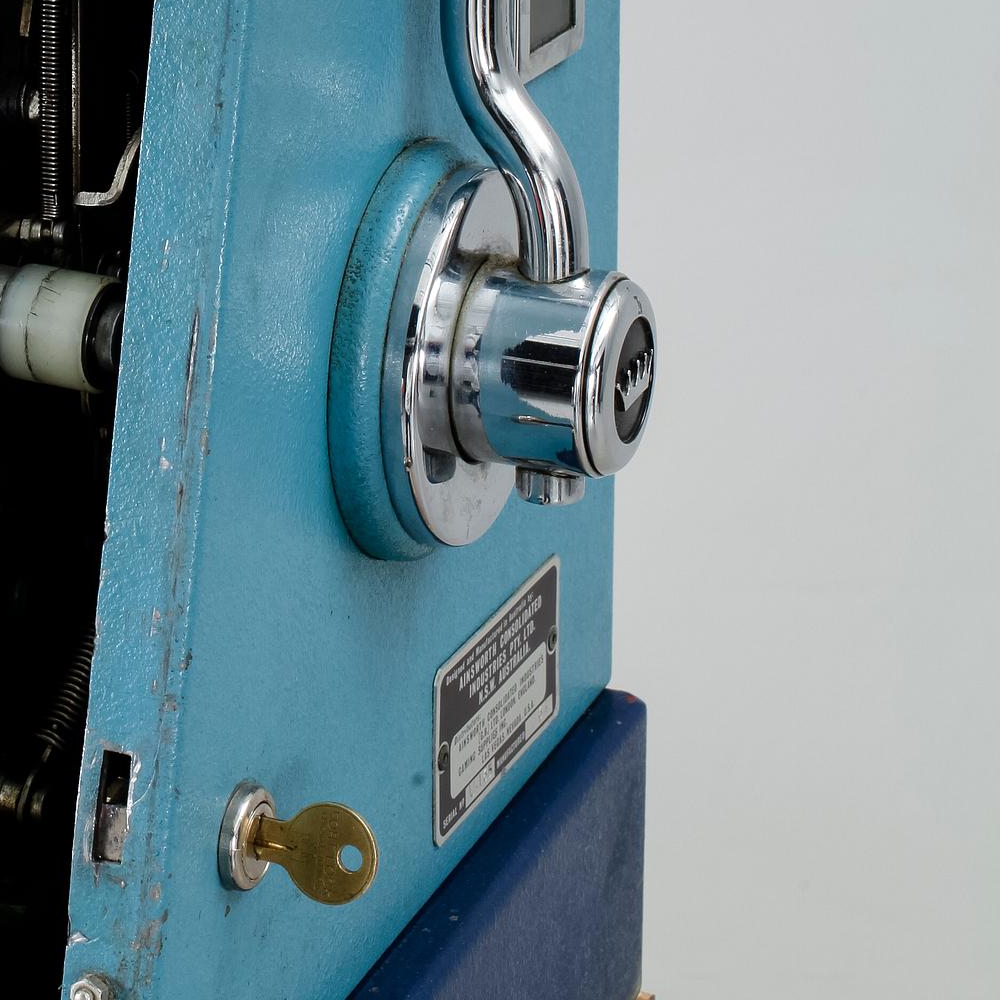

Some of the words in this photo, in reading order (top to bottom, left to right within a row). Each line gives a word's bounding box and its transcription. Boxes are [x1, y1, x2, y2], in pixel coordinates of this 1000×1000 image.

[458, 642, 496, 691] AINSWORTH
[500, 594, 542, 649] CONSOLIDATED
[469, 649, 506, 698] INDUSTRIES
[523, 618, 536, 641] LTD.
